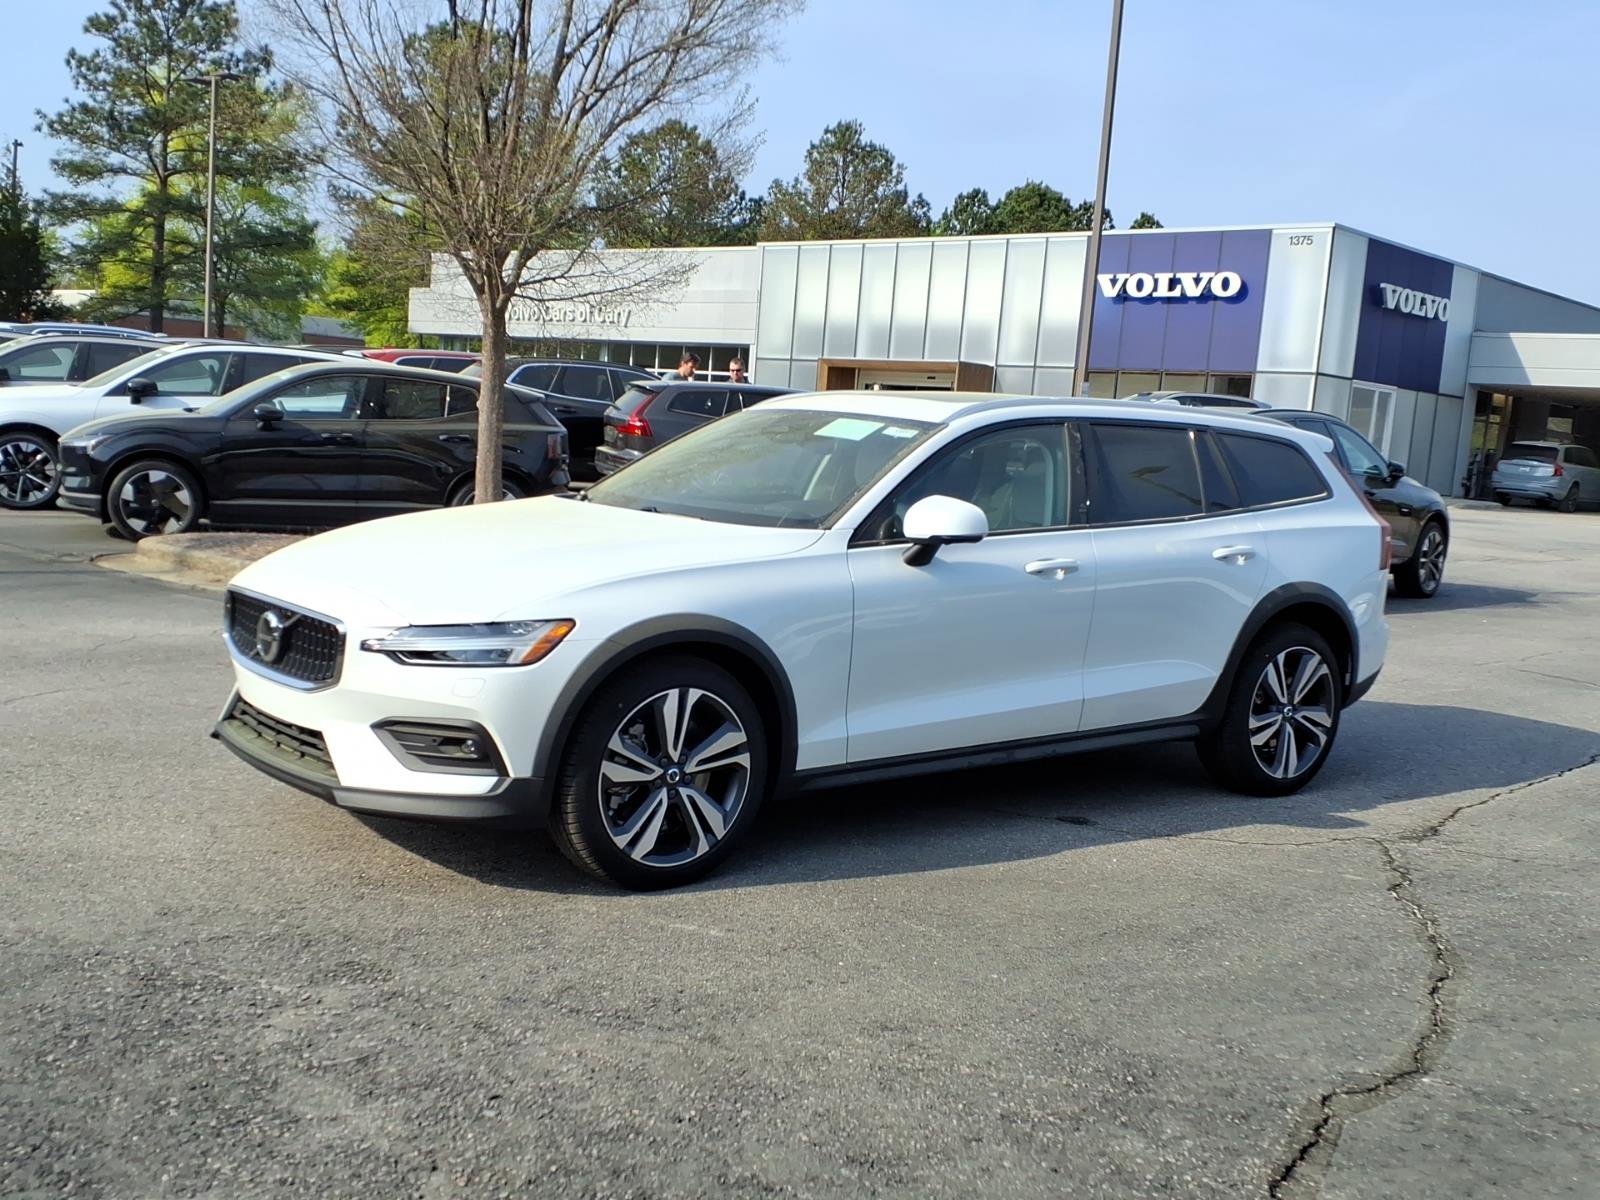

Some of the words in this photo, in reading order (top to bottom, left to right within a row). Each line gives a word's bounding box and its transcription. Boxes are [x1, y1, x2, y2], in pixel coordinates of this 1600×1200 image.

[1289, 235, 1313, 246] 1375
[1097, 271, 1242, 298] VOLVO
[542, 304, 575, 322] Cars
[577, 302, 592, 323] of
[594, 305, 631, 328] Cary
[1380, 282, 1450, 322] VOLVO
